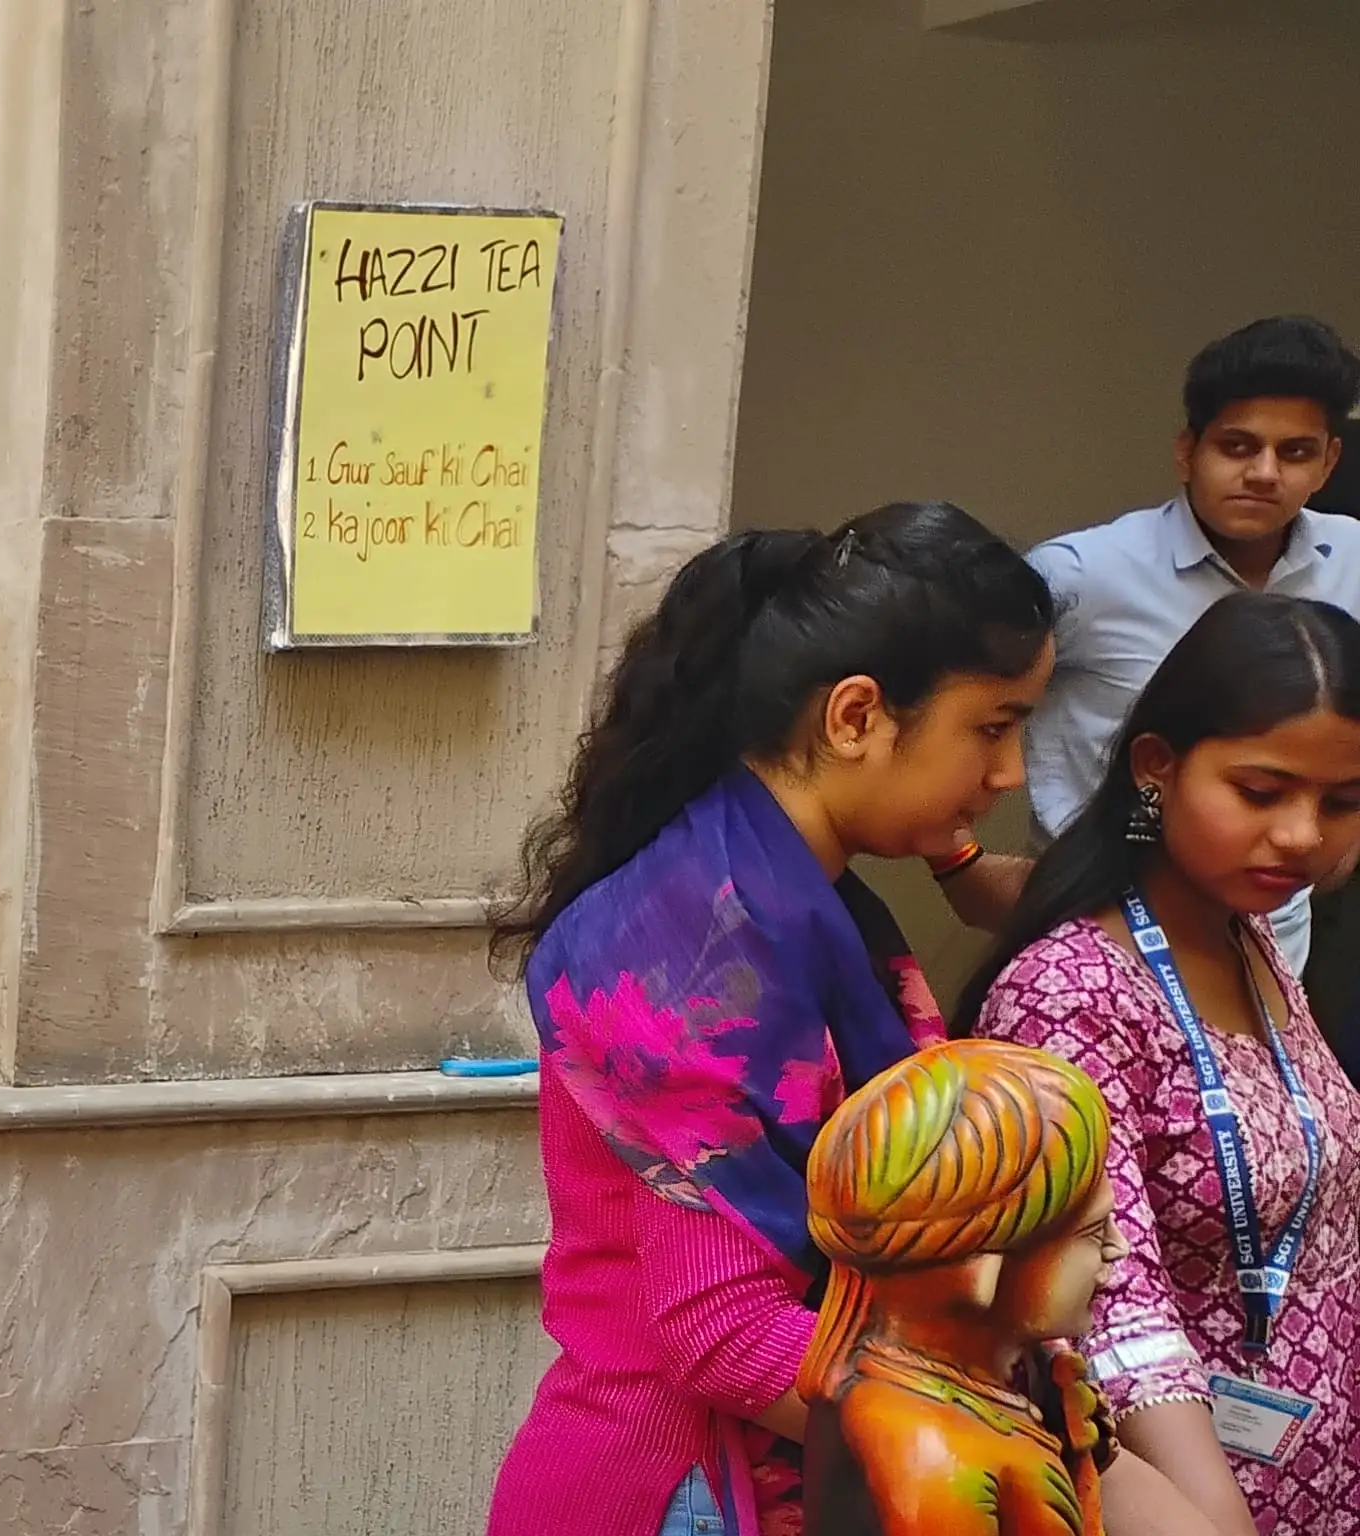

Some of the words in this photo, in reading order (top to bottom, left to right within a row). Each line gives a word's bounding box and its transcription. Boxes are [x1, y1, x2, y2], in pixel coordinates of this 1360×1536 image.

[335, 238, 459, 302] HAZZI
[480, 239, 540, 292] TEA
[358, 309, 490, 381] POINT
[327, 441, 375, 485] Gur
[471, 444, 532, 487] Chai
[457, 501, 522, 548] Chai
[1158, 963, 1205, 1050] UNIVERSITY
[1197, 1056, 1216, 1086] SGT
[1216, 1130, 1248, 1229] UNIVERSITY
[1236, 1234, 1254, 1264] SGT
[1273, 1233, 1295, 1265] SGT
